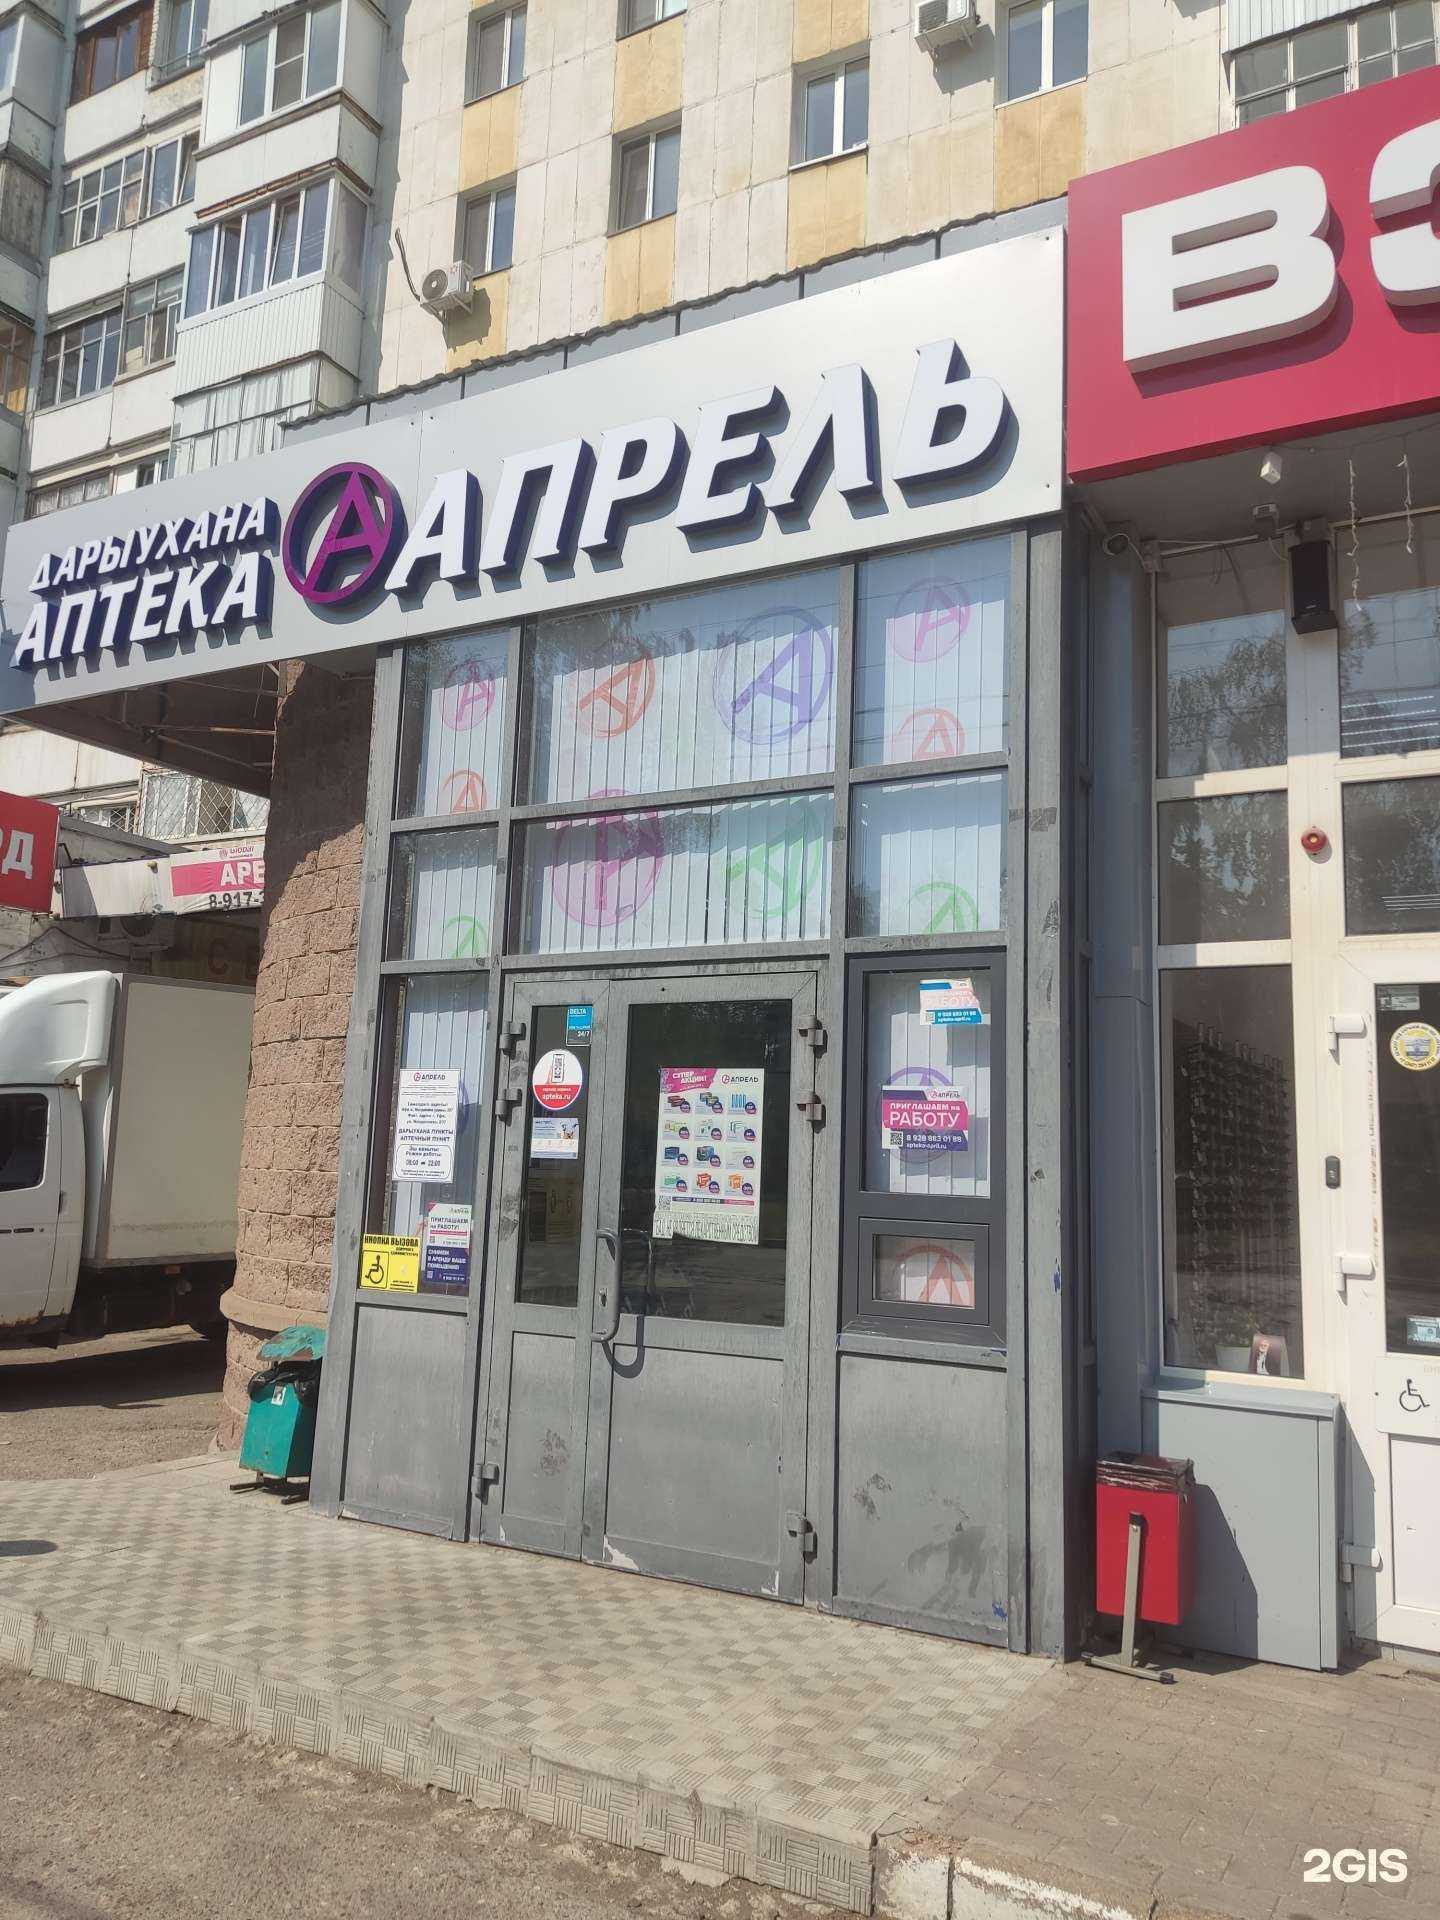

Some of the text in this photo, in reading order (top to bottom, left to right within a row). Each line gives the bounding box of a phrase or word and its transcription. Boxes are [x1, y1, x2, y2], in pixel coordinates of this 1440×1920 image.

[385, 337, 1008, 590] АПРЕЛЬ
[29, 497, 268, 592] ДАРЫУХАНА
[12, 551, 263, 664] АПТЕКА
[889, 1102, 949, 1111] ПРИГЛАШАЕМ
[889, 1111, 961, 1127] РАБОТУ
